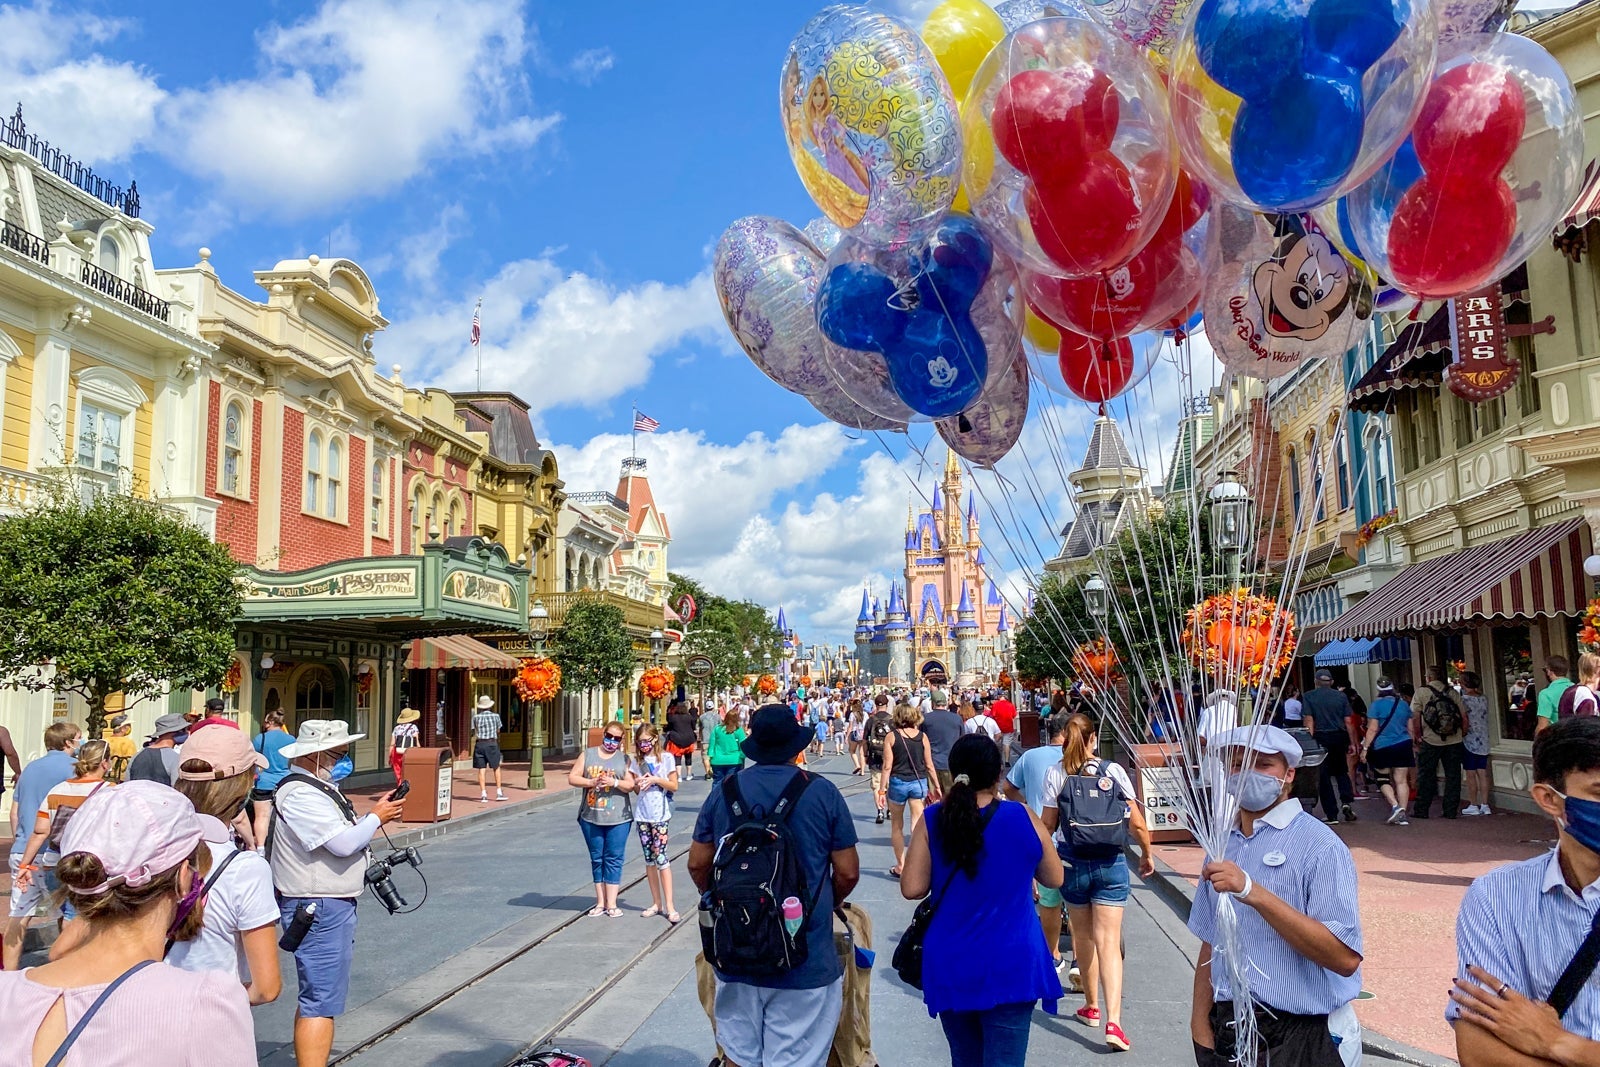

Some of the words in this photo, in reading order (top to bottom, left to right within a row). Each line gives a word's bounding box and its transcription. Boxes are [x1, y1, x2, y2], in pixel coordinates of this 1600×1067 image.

[1229, 295, 1248, 324] Walt
[1465, 296, 1495, 360] ARTS
[1237, 316, 1268, 361] Disney
[1272, 351, 1300, 363] World
[277, 586, 300, 598] Main
[302, 581, 330, 596] Street
[340, 572, 412, 595] FASHION
[373, 583, 414, 595] APPAREL
[497, 640, 529, 650] HOUSE
